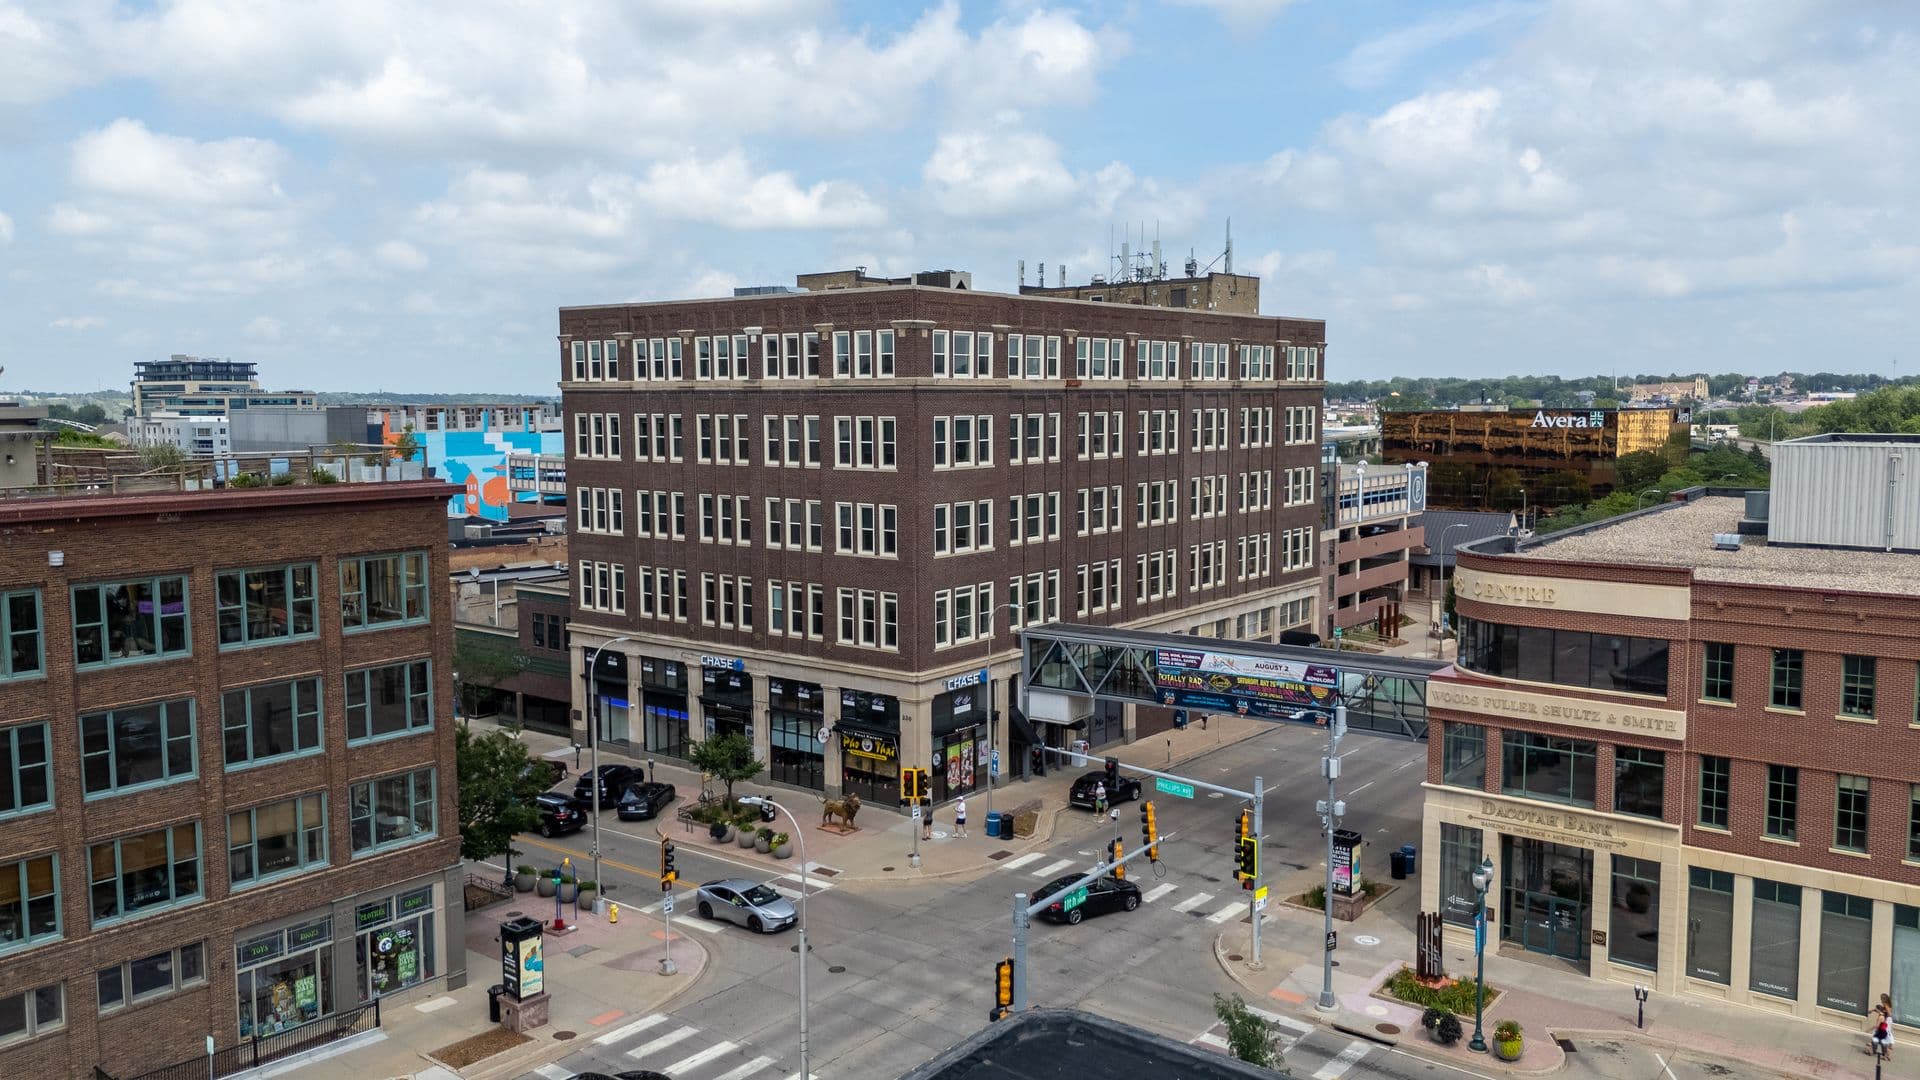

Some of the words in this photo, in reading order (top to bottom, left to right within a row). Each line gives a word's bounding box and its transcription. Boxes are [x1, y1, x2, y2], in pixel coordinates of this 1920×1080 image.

[1531, 410, 1587, 428] Avera
[1473, 580, 1556, 603] CENTRE
[701, 655, 733, 669] CHASE
[1255, 663, 1283, 671] AUGUST
[947, 673, 981, 690] CHASE
[1158, 672, 1186, 683] TOTALLY
[1189, 675, 1203, 685] RAD
[1431, 690, 1479, 707] WOODS
[1483, 696, 1538, 714] FULLER
[1542, 704, 1601, 722] SHULTZ
[1606, 713, 1617, 724] &
[1622, 714, 1677, 732] SMITH
[842, 736, 860, 749] Pho
[875, 740, 895, 757] Thai
[1157, 781, 1181, 793] PHILLIPS
[1697, 967, 1720, 977] BANKING
[1758, 981, 1789, 992] INSURANCE
[1827, 996, 1857, 1008] MORTGAGE
